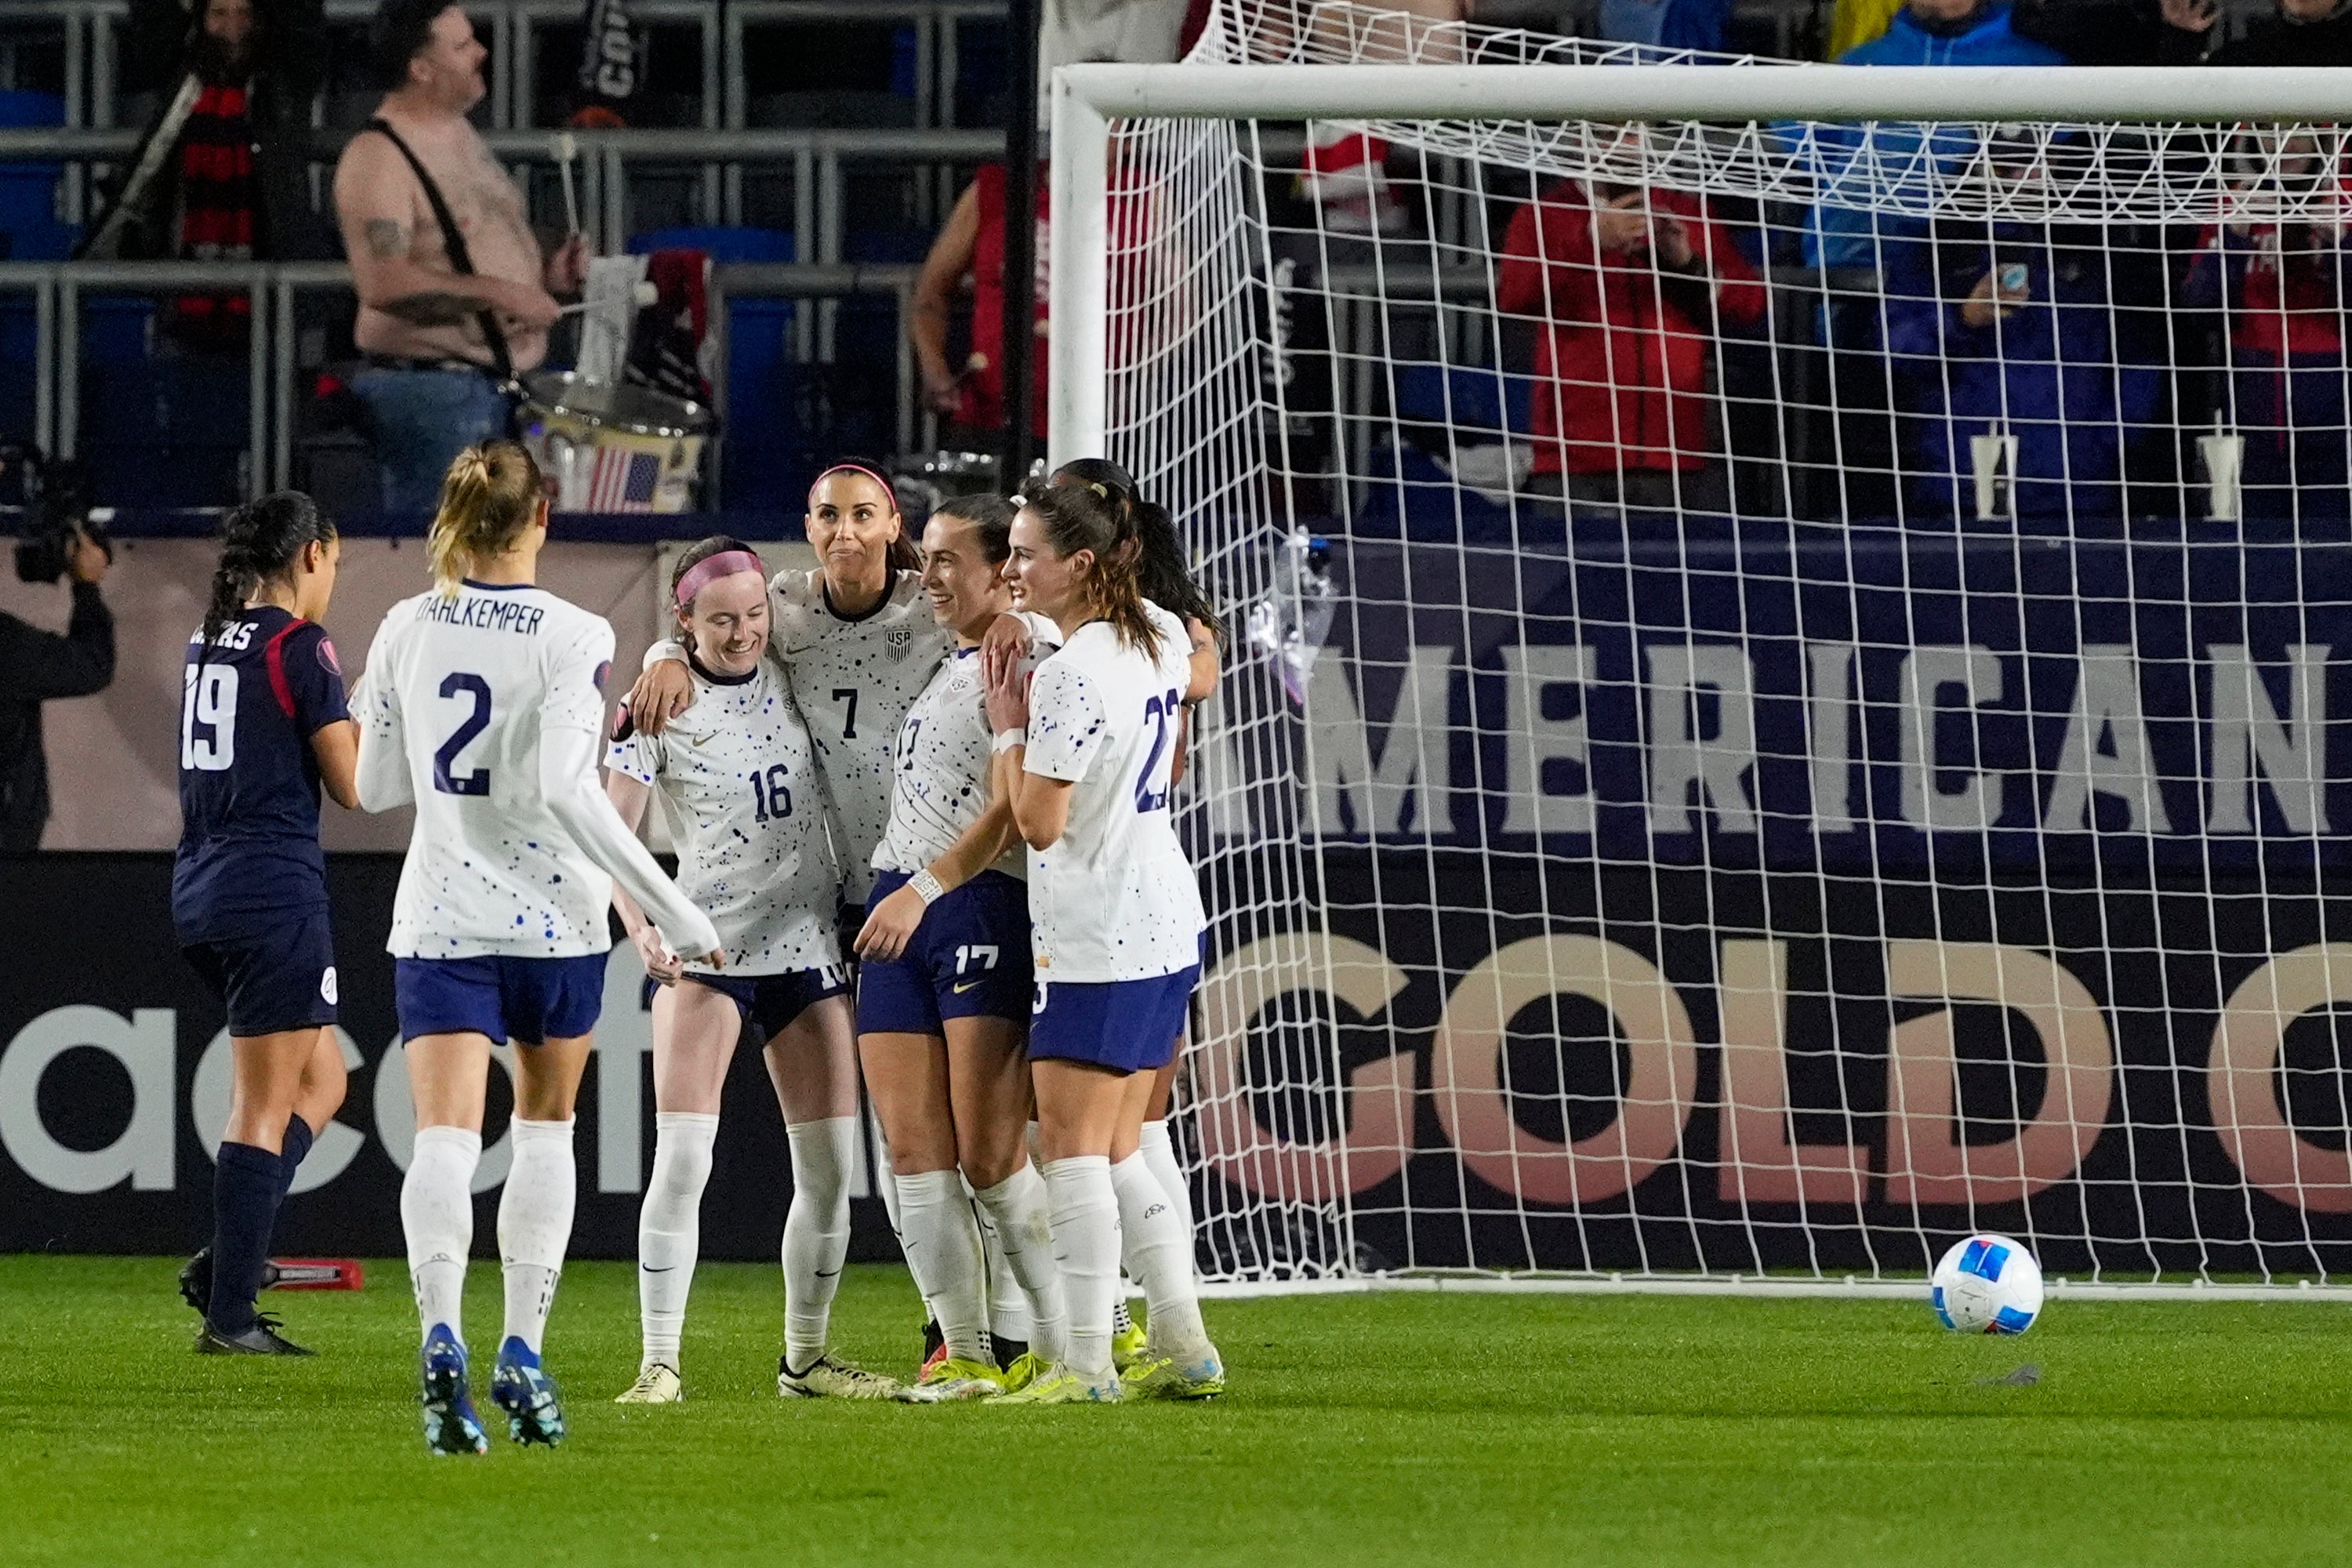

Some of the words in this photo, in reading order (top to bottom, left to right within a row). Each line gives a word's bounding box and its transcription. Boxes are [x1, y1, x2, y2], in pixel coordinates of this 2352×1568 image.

[887, 631, 910, 645] USA
[181, 663, 239, 771] 19
[434, 671, 492, 797] 2
[832, 688, 858, 739] 7
[897, 717, 921, 771] 17
[750, 763, 793, 822] 16
[955, 945, 999, 975] 17
[1196, 931, 2113, 1205] GOLD
